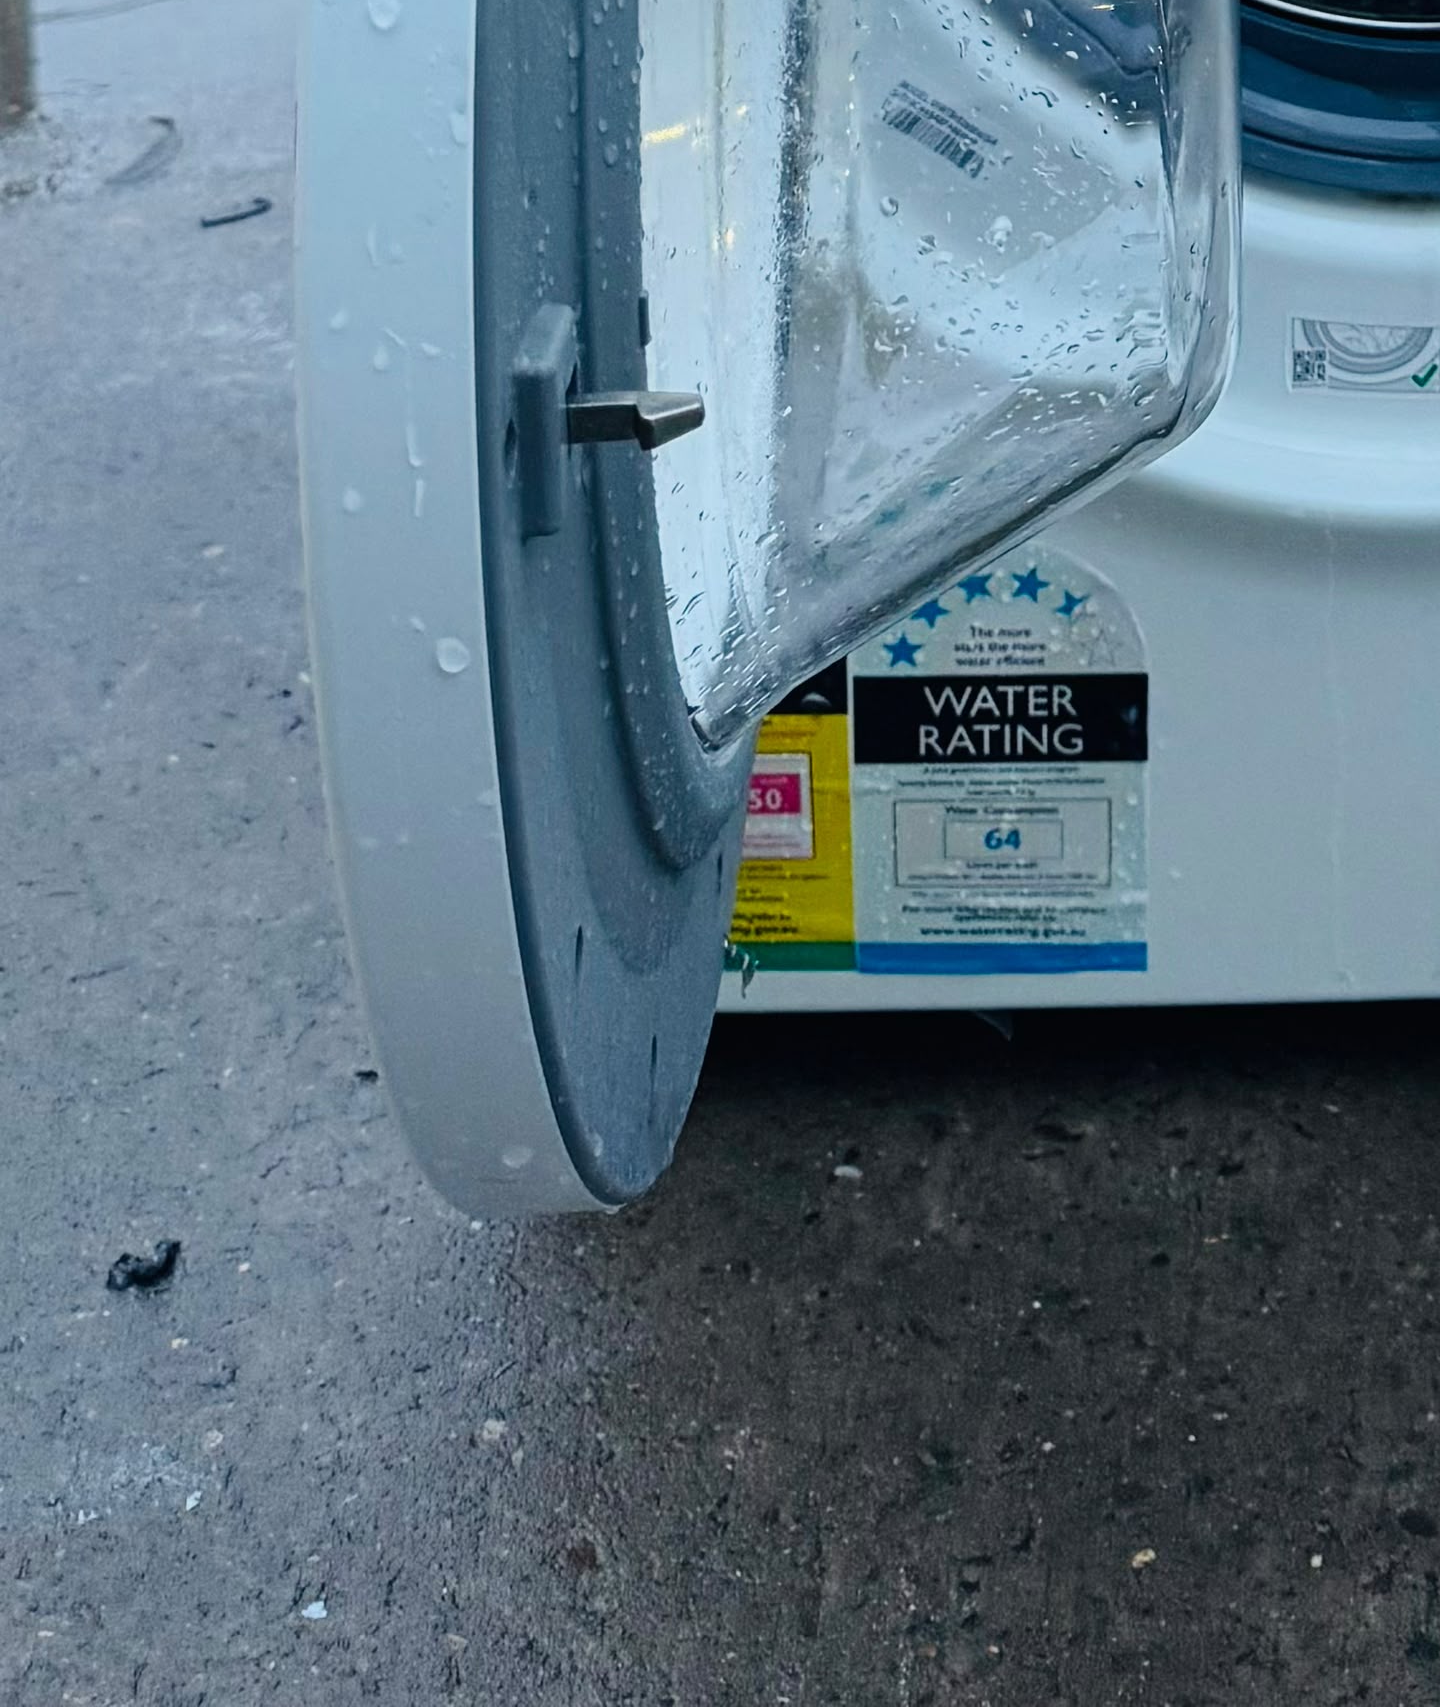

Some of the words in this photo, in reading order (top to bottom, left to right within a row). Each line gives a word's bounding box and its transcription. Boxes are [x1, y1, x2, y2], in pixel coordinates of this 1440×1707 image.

[924, 685, 1078, 717] WATER
[919, 723, 1083, 756] RATING
[984, 827, 1021, 851] 64
